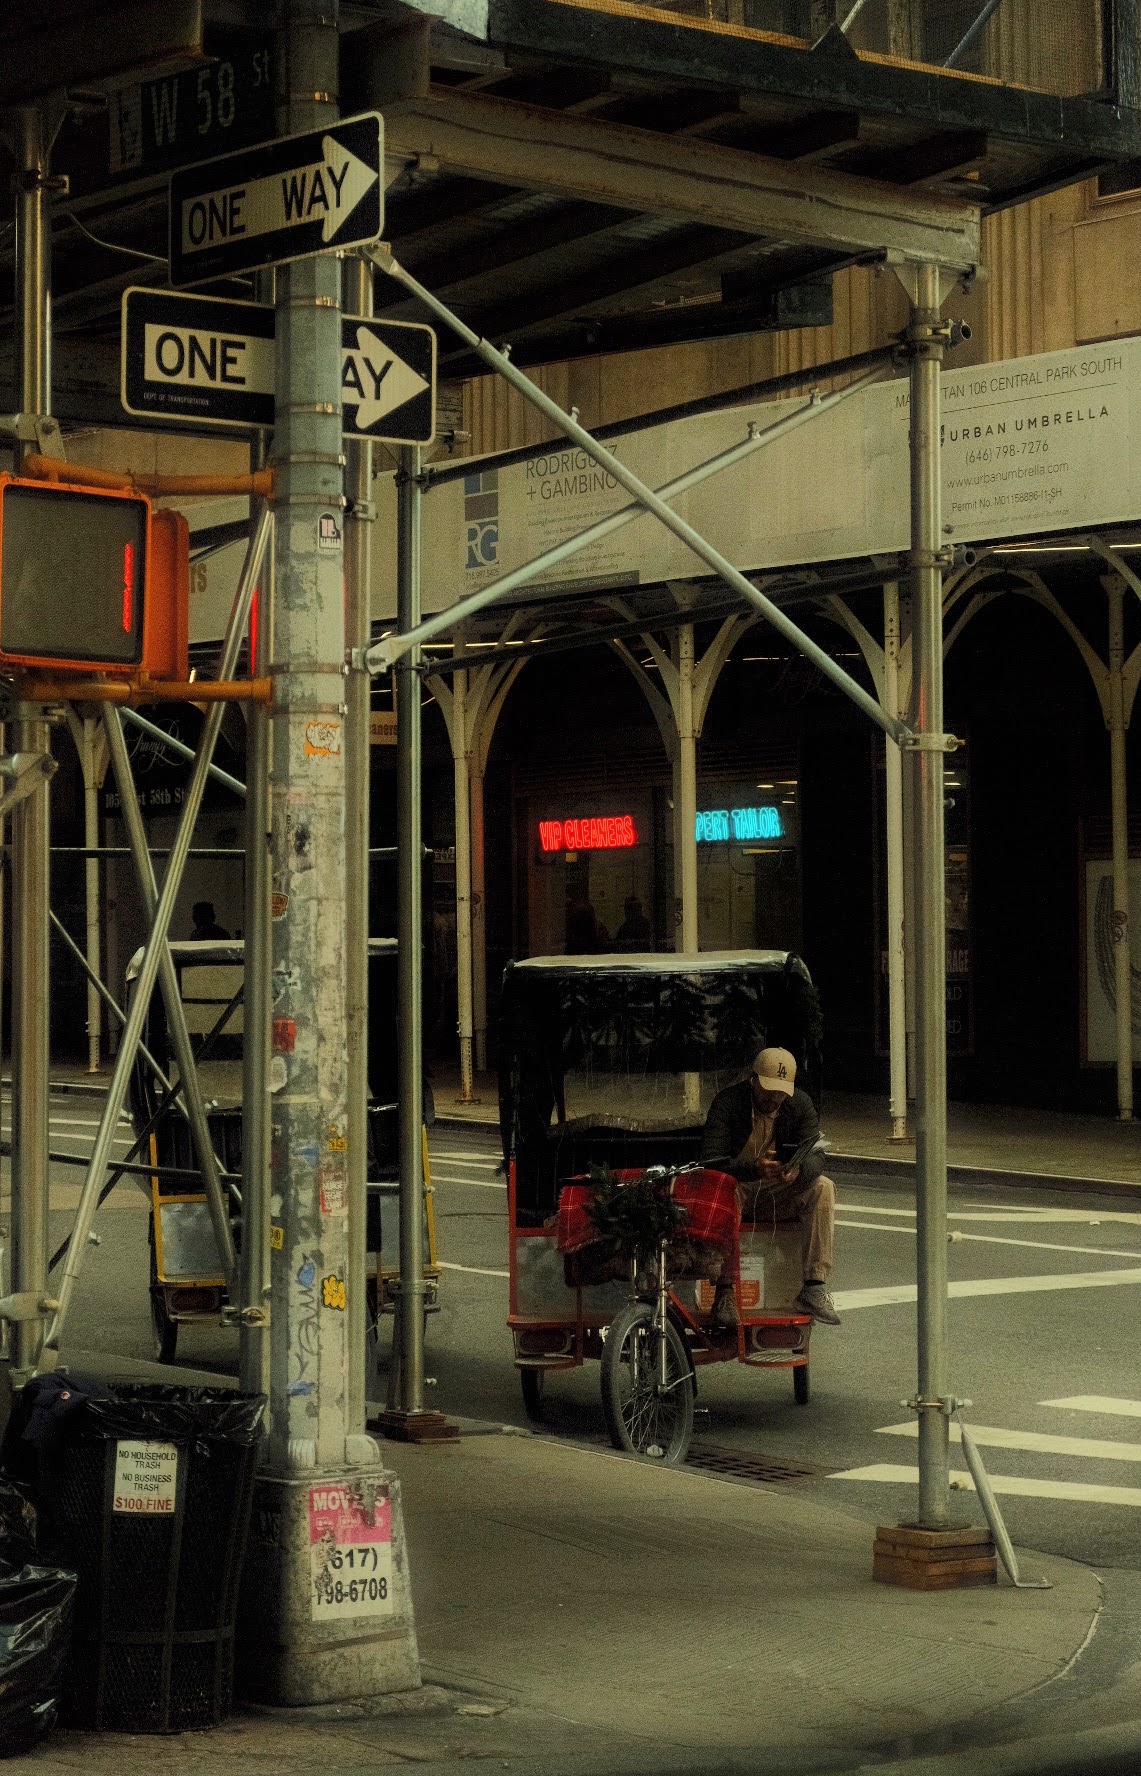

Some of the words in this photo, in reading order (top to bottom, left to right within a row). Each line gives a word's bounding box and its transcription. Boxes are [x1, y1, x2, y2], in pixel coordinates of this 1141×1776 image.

[150, 78, 179, 147] W
[196, 61, 236, 136] 58
[252, 49, 271, 87] St
[188, 189, 247, 246] ONE
[281, 161, 350, 221] WAY
[155, 331, 246, 385] ONE
[342, 353, 393, 401] AY
[969, 380, 988, 397] 106
[990, 373, 1043, 393] CENTRAL
[1046, 365, 1078, 383] PARK
[1080, 356, 1122, 377] SOUTH
[950, 422, 1006, 442] URBAN
[1015, 405, 1109, 432] UMBRELLA
[965, 446, 993, 465] (646)
[996, 439, 1050, 460] 798-7276
[946, 461, 1069, 489] www.urbanumbrella.com
[951, 500, 978, 512] Permit
[149, 787, 171, 805] 58th
[539, 821, 562, 851] VIP
[564, 815, 636, 849] CLEANERS
[696, 810, 730, 842] PERT
[731, 807, 782, 839] TAILOR
[777, 1062, 787, 1079] LA
[118, 1450, 130, 1459] NO
[131, 1451, 176, 1461] HOUSEHOLD
[135, 1460, 161, 1470] TRASH
[122, 1472, 133, 1482] NO
[134, 1473, 172, 1483] BUSINESS
[133, 1482, 159, 1492] TRASH
[115, 1496, 143, 1510] $100
[146, 1499, 172, 1511] FINE
[331, 1547, 378, 1572] 617)
